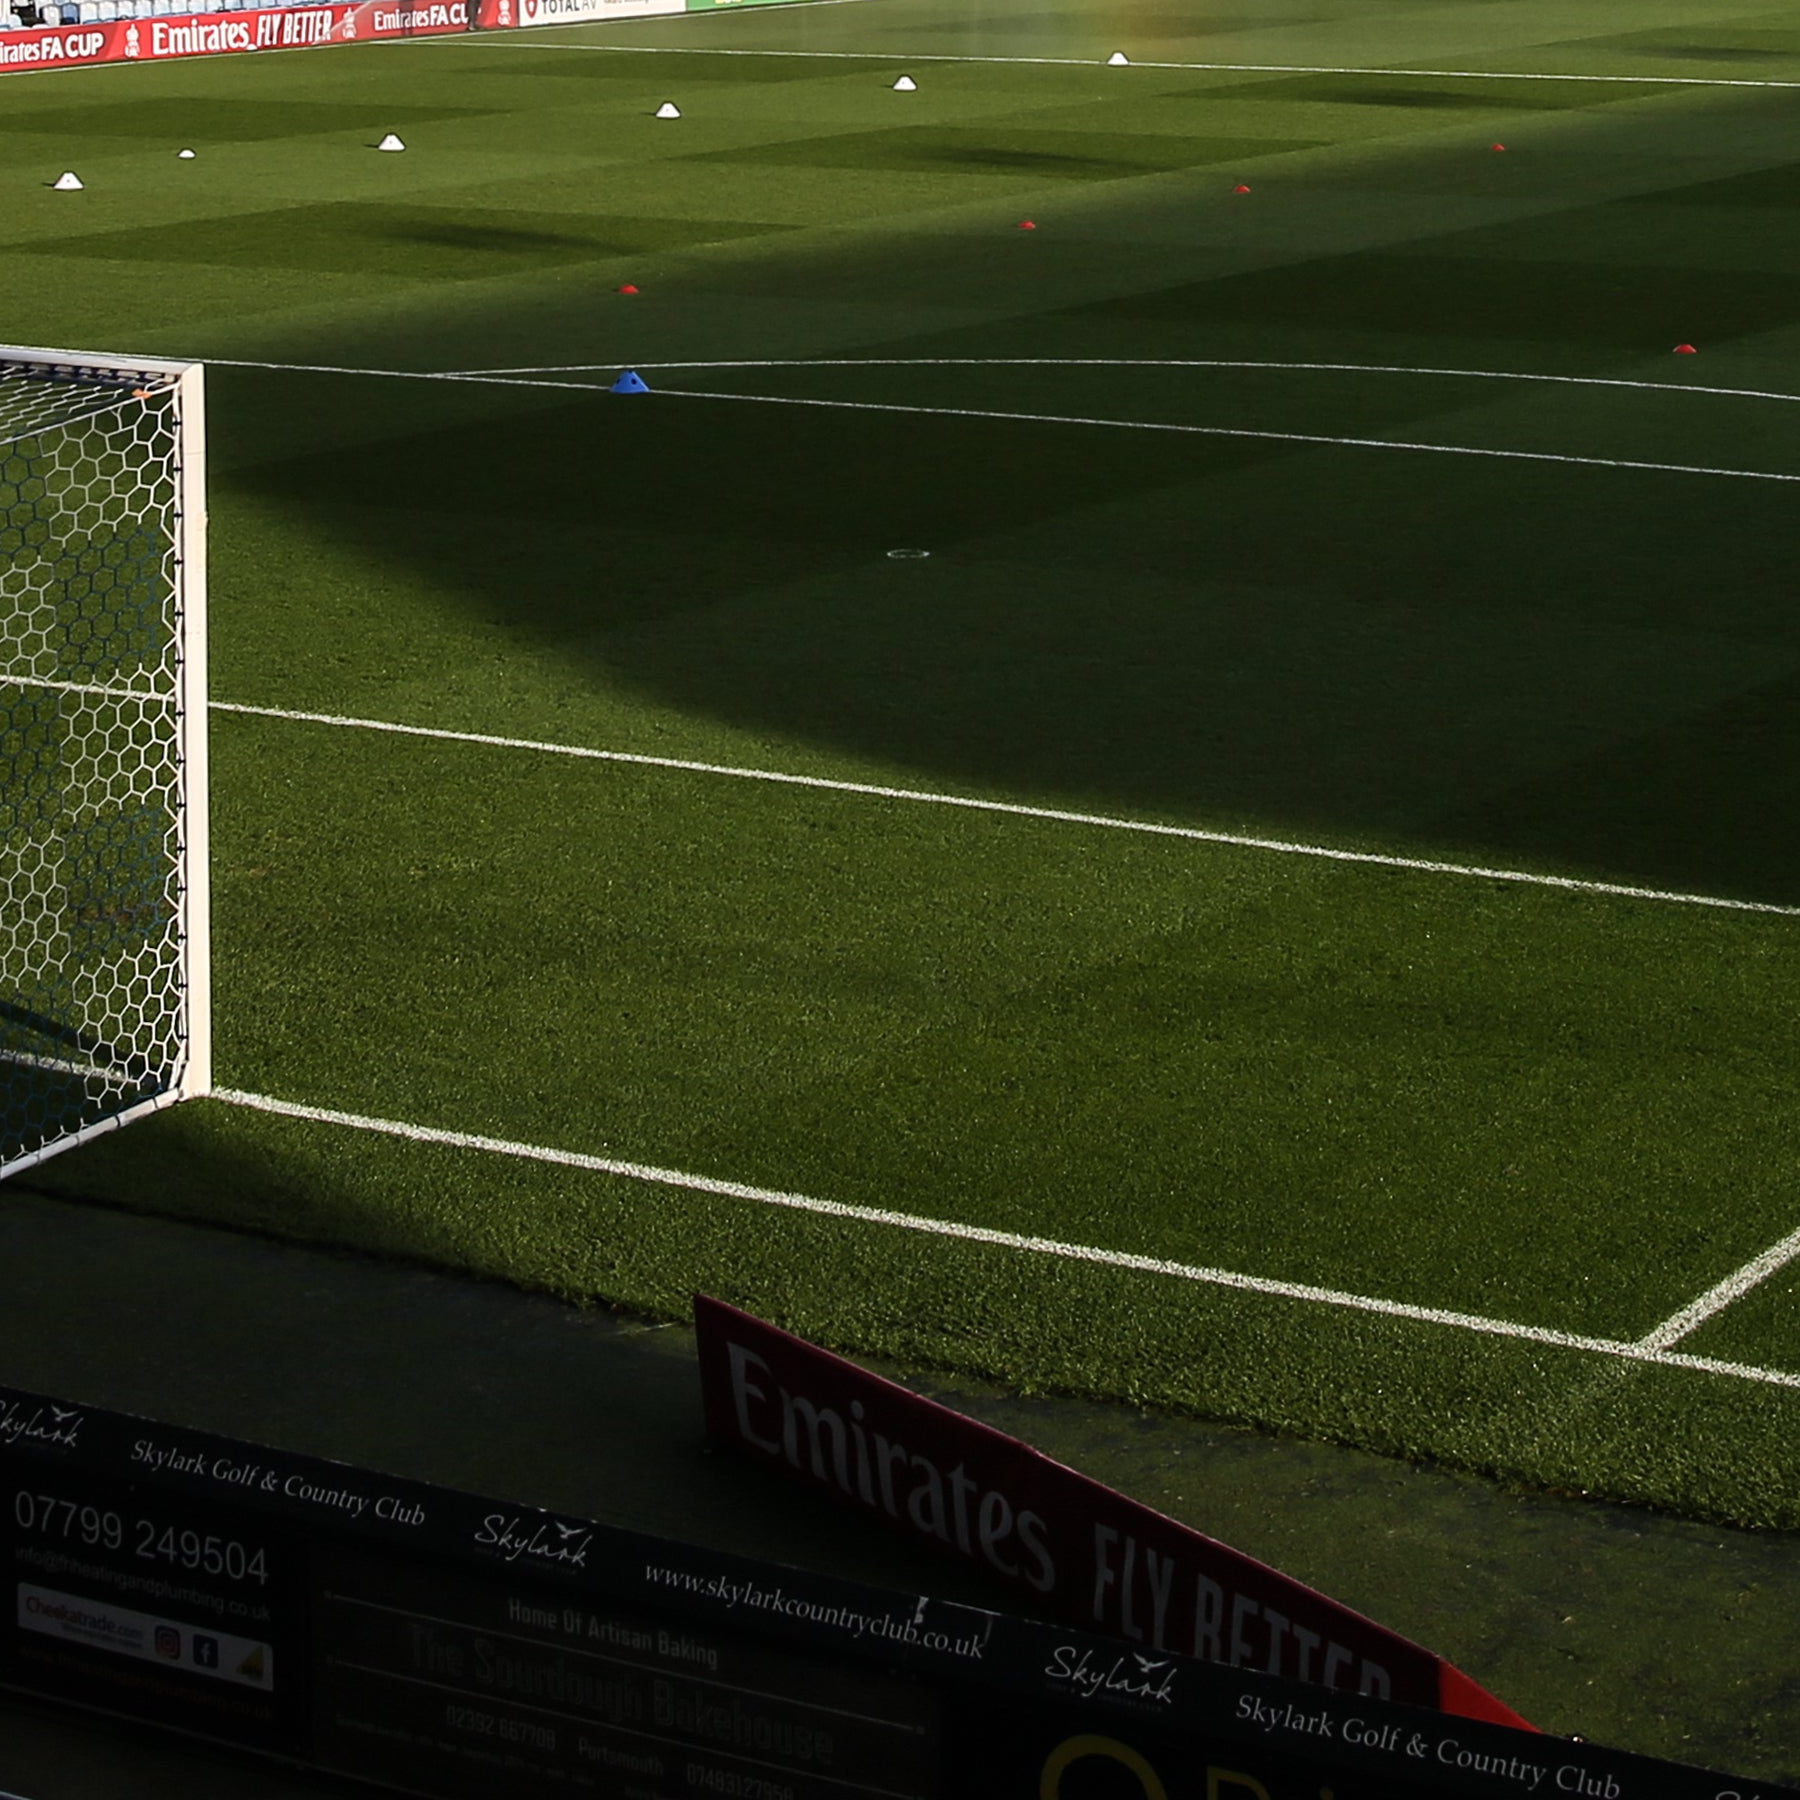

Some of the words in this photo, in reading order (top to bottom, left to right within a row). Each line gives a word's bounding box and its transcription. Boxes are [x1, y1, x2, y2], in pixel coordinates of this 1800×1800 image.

[40, 36, 63, 60] FA
[65, 31, 104, 58] CUP
[152, 17, 250, 54] Emirates
[256, 11, 283, 46] FLY
[283, 9, 333, 44] BETTER
[373, 8, 429, 32] Emirates
[430, 5, 449, 26] FA
[131, 1438, 206, 1477] Skylark
[211, 1457, 260, 1490] Golf
[260, 1470, 279, 1492] &
[283, 1474, 370, 1519] Country
[375, 1496, 427, 1526] Club
[726, 1340, 1057, 1594] Emirates
[1093, 1520, 1176, 1652] FLY
[15, 1489, 123, 1550] 07799
[134, 1519, 271, 1586] 249504
[474, 1514, 594, 1568] Skylark
[508, 1597, 559, 1630] Home
[563, 1610, 583, 1637] Of
[588, 1616, 653, 1654] Artisan
[658, 1630, 719, 1672] Baking
[644, 1564, 986, 1660] www.skylarkcountryclub.co.uk
[1045, 1645, 1177, 1705] Skylark
[1235, 1693, 1333, 1739] Skylark
[1341, 1717, 1402, 1758] Golf
[1405, 1733, 1429, 1760] &
[1437, 1738, 1548, 1794] Country
[1555, 1764, 1622, 1800] Club
